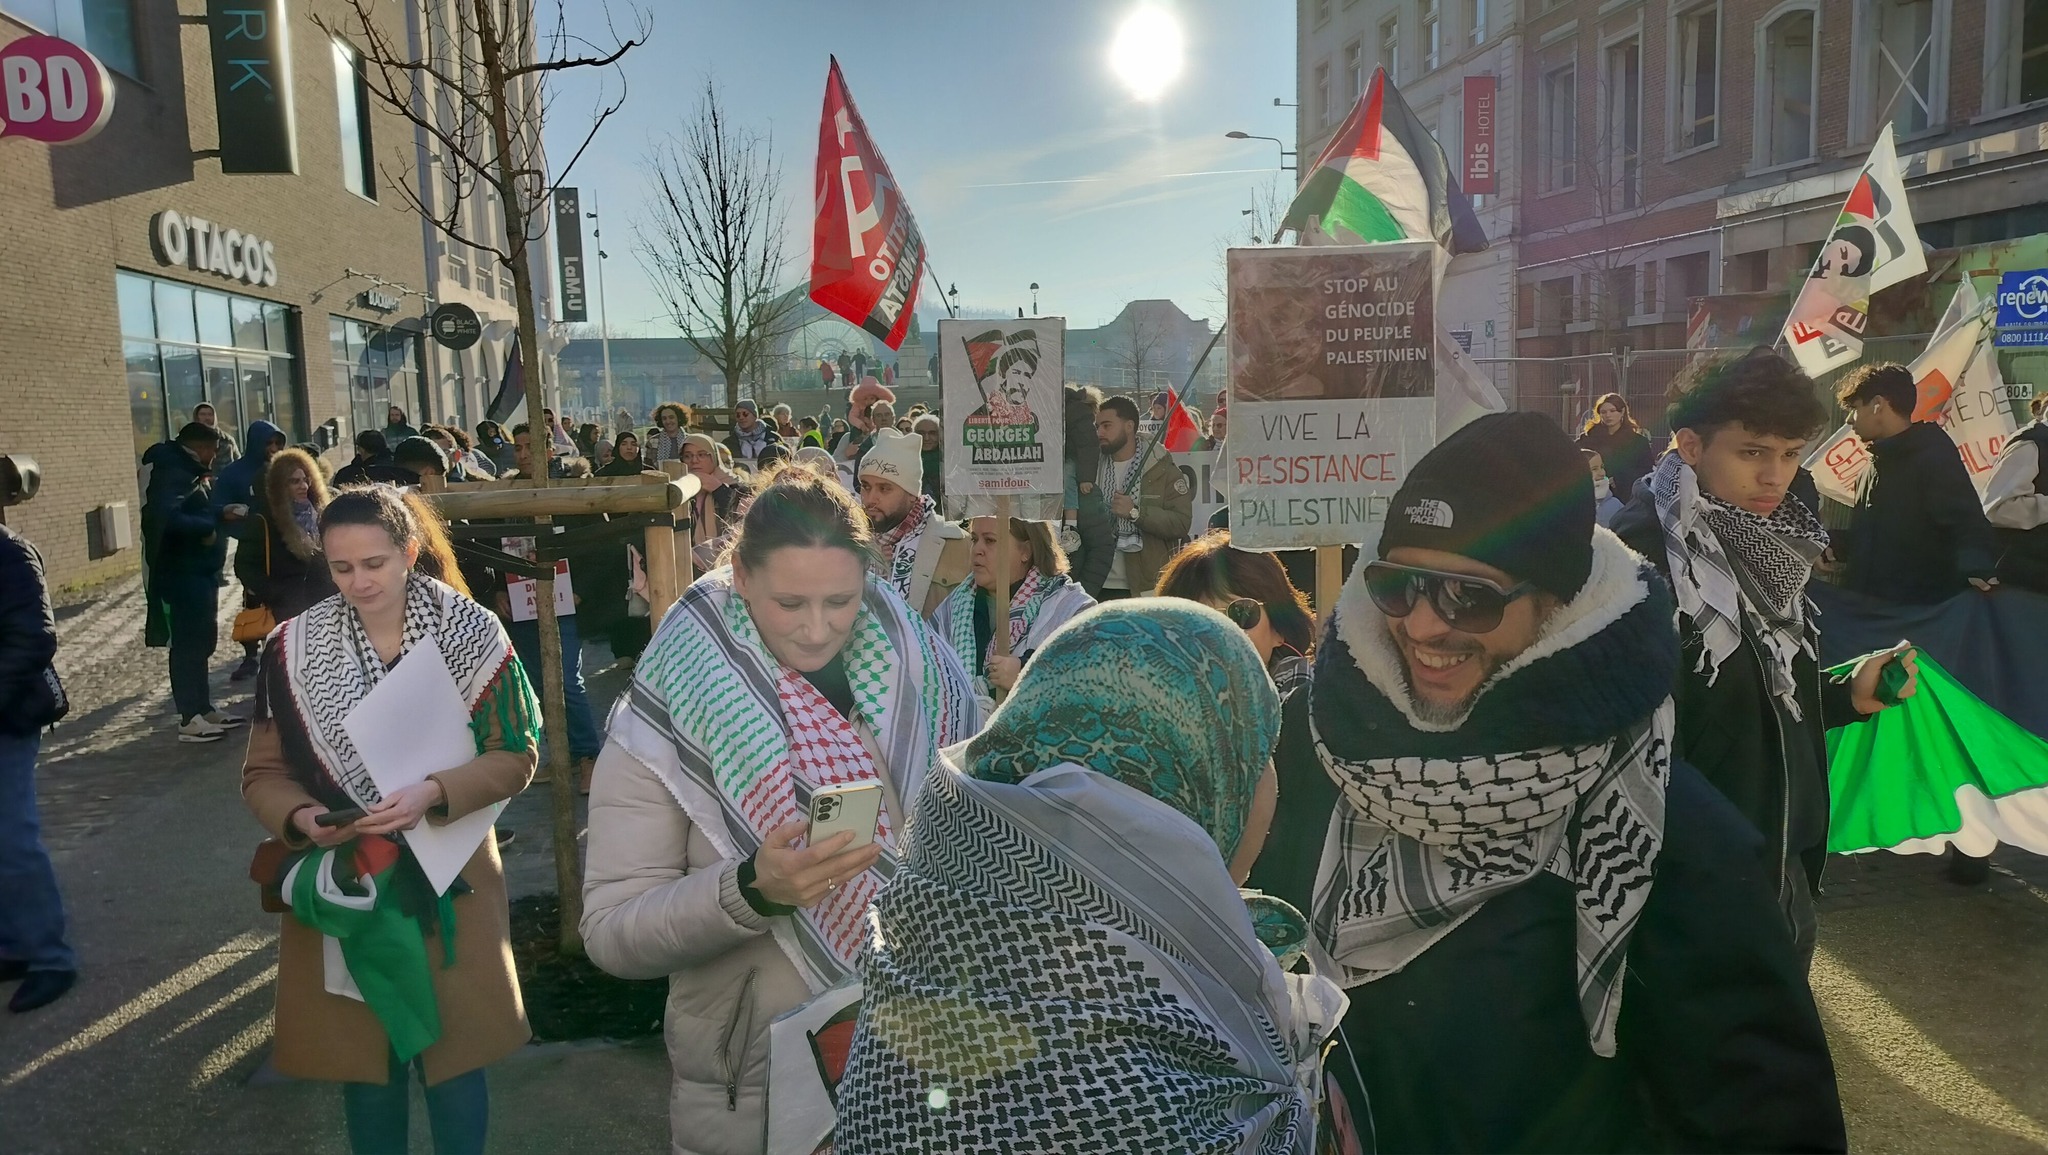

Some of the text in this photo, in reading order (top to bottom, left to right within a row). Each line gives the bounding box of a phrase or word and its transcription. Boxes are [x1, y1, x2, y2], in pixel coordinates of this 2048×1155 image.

[3, 55, 88, 123] BD
[1470, 93, 1490, 179] ibis HOTEL
[158, 209, 278, 287] O'TACOS
[1324, 277, 1398, 295] STOP AU
[1325, 301, 1416, 319] GÉNOCIDE
[1326, 326, 1412, 343] DU PEUPLE
[2001, 333, 2021, 343] 0800
[1326, 347, 1428, 365] PALESTINIEN
[966, 427, 1031, 443] GEORGES
[1261, 411, 1371, 441] VIVE LA
[974, 446, 1042, 461] ABDALLAH
[1236, 453, 1397, 485] RÉSISTANCE
[978, 477, 1030, 488] samidoun
[1240, 496, 1391, 527] PALESTINIE
[1404, 507, 1437, 517] NORTH
[1420, 498, 1439, 508] THE
[1410, 515, 1434, 525] FACE
